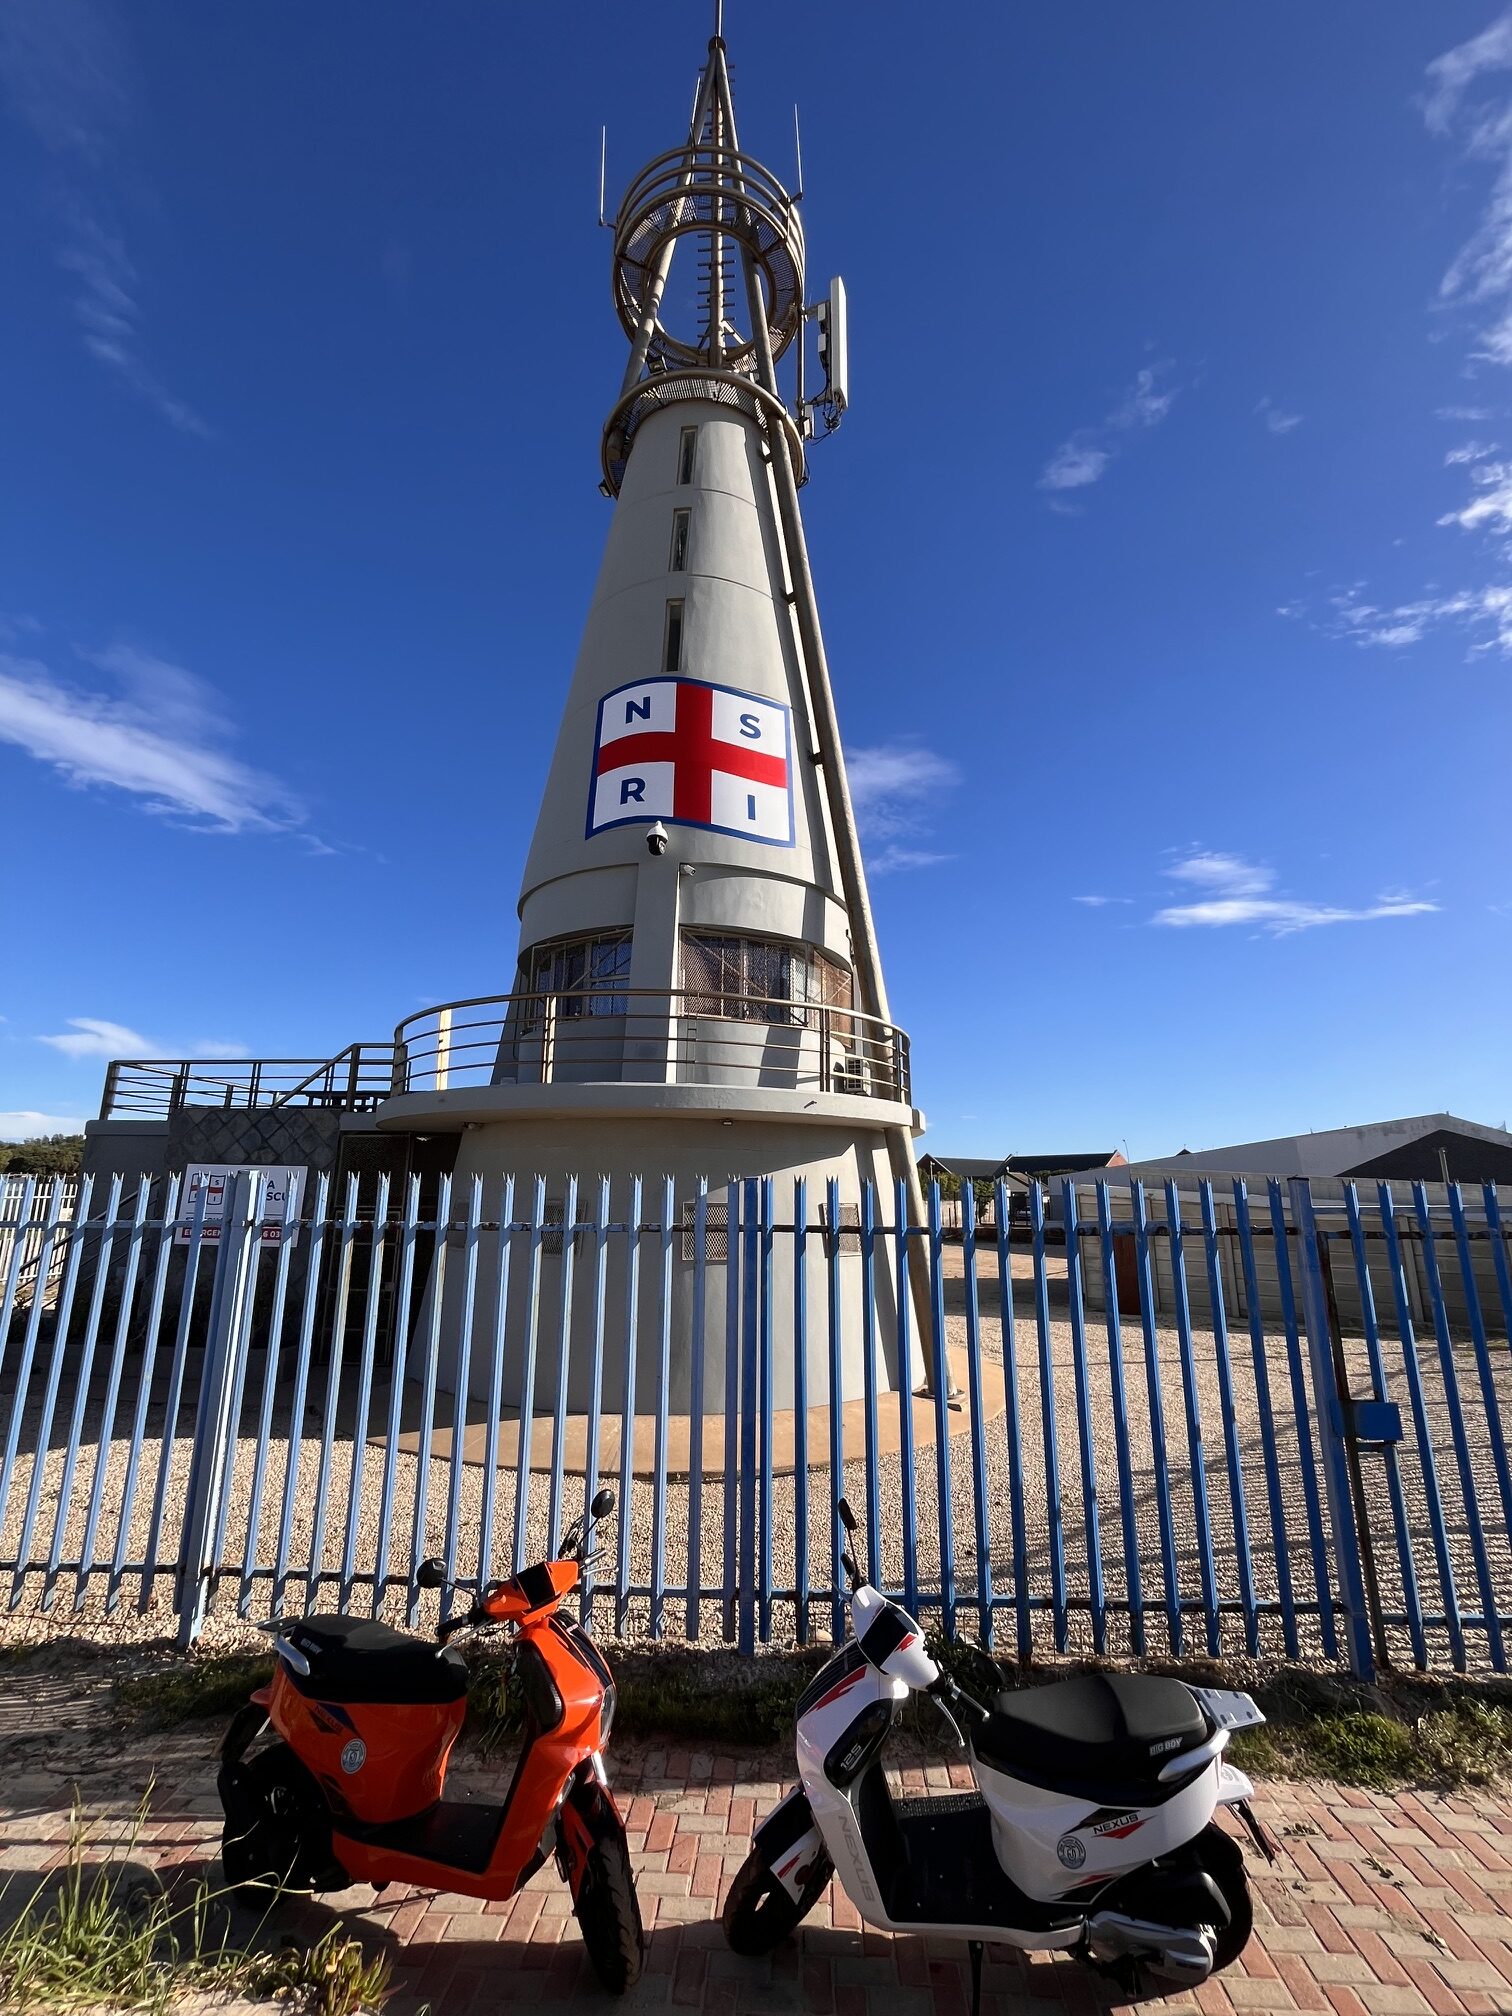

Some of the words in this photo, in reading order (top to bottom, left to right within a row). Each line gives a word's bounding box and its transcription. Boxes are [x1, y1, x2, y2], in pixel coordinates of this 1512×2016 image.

[625, 696, 650, 724] N
[739, 713, 761, 739] S
[620, 777, 645, 805] R
[747, 794, 756, 821] I
[840, 1742, 862, 1769] 125
[1164, 1737, 1183, 1751] BOY
[1093, 1813, 1139, 1835] NEXUS
[838, 1815, 875, 1902] NEXUS
